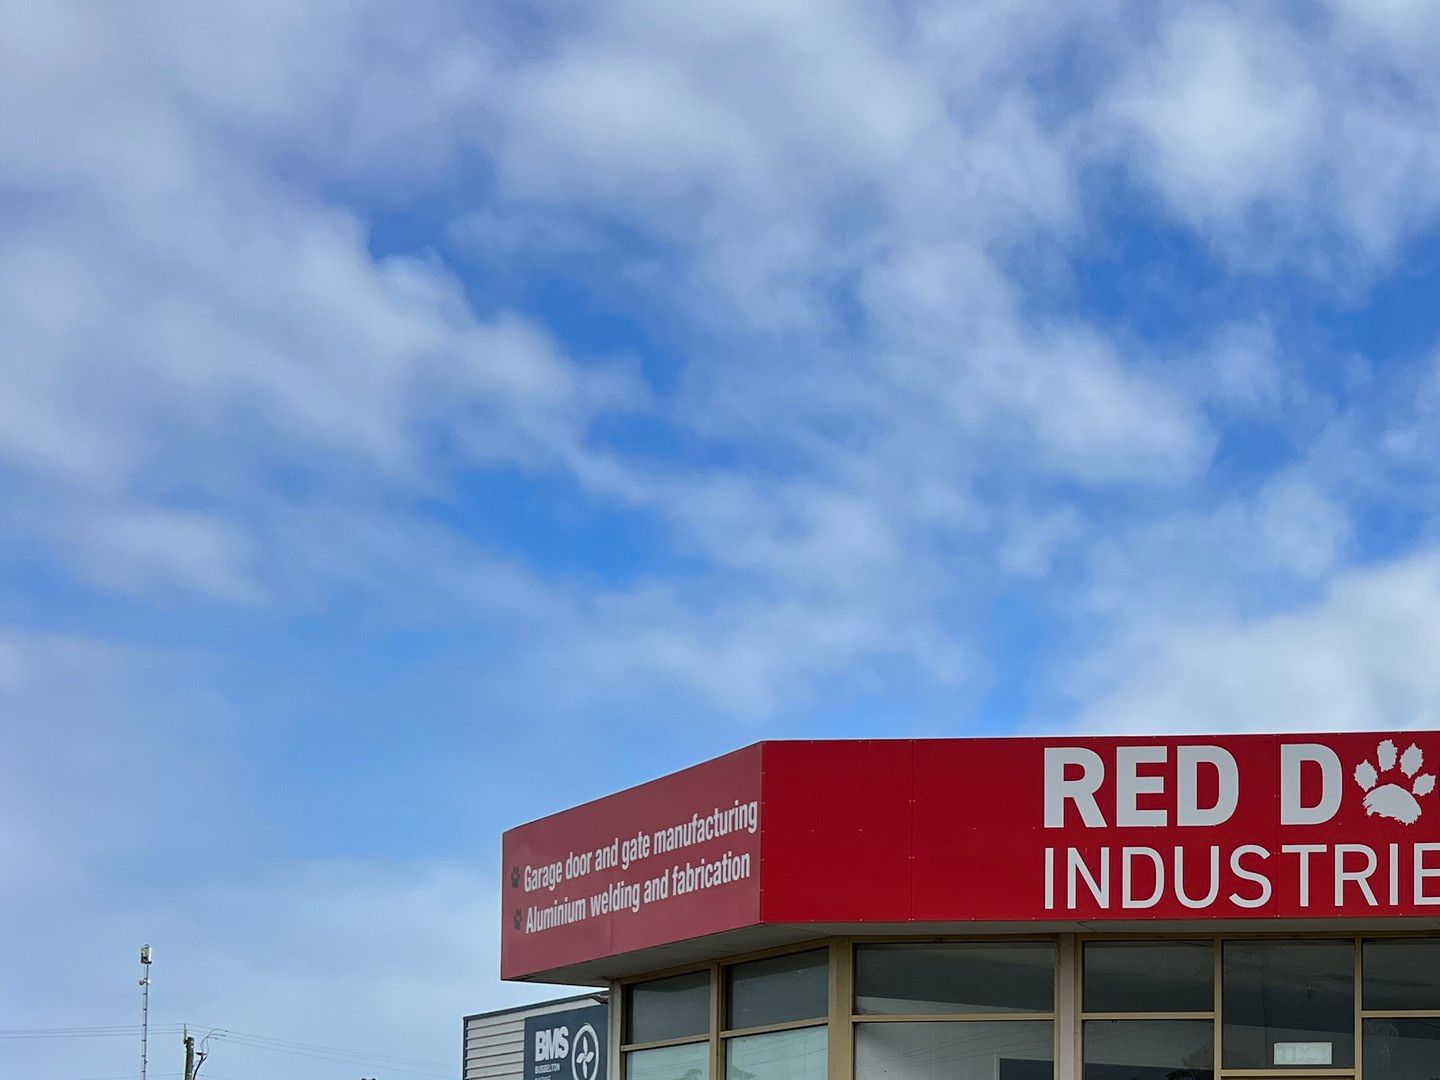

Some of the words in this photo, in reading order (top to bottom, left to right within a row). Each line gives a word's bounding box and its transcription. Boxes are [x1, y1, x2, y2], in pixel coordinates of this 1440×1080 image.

[1044, 745, 1239, 828] RED
[524, 863, 562, 892] Garage
[565, 852, 592, 880] door
[595, 838, 618, 872] and
[622, 831, 650, 870] gate
[653, 800, 758, 854] manufacturing
[526, 898, 586, 934] Aluminium
[590, 880, 640, 917] welding
[644, 869, 668, 903] and
[672, 851, 750, 896] fabrication
[535, 1026, 569, 1062] BMS
